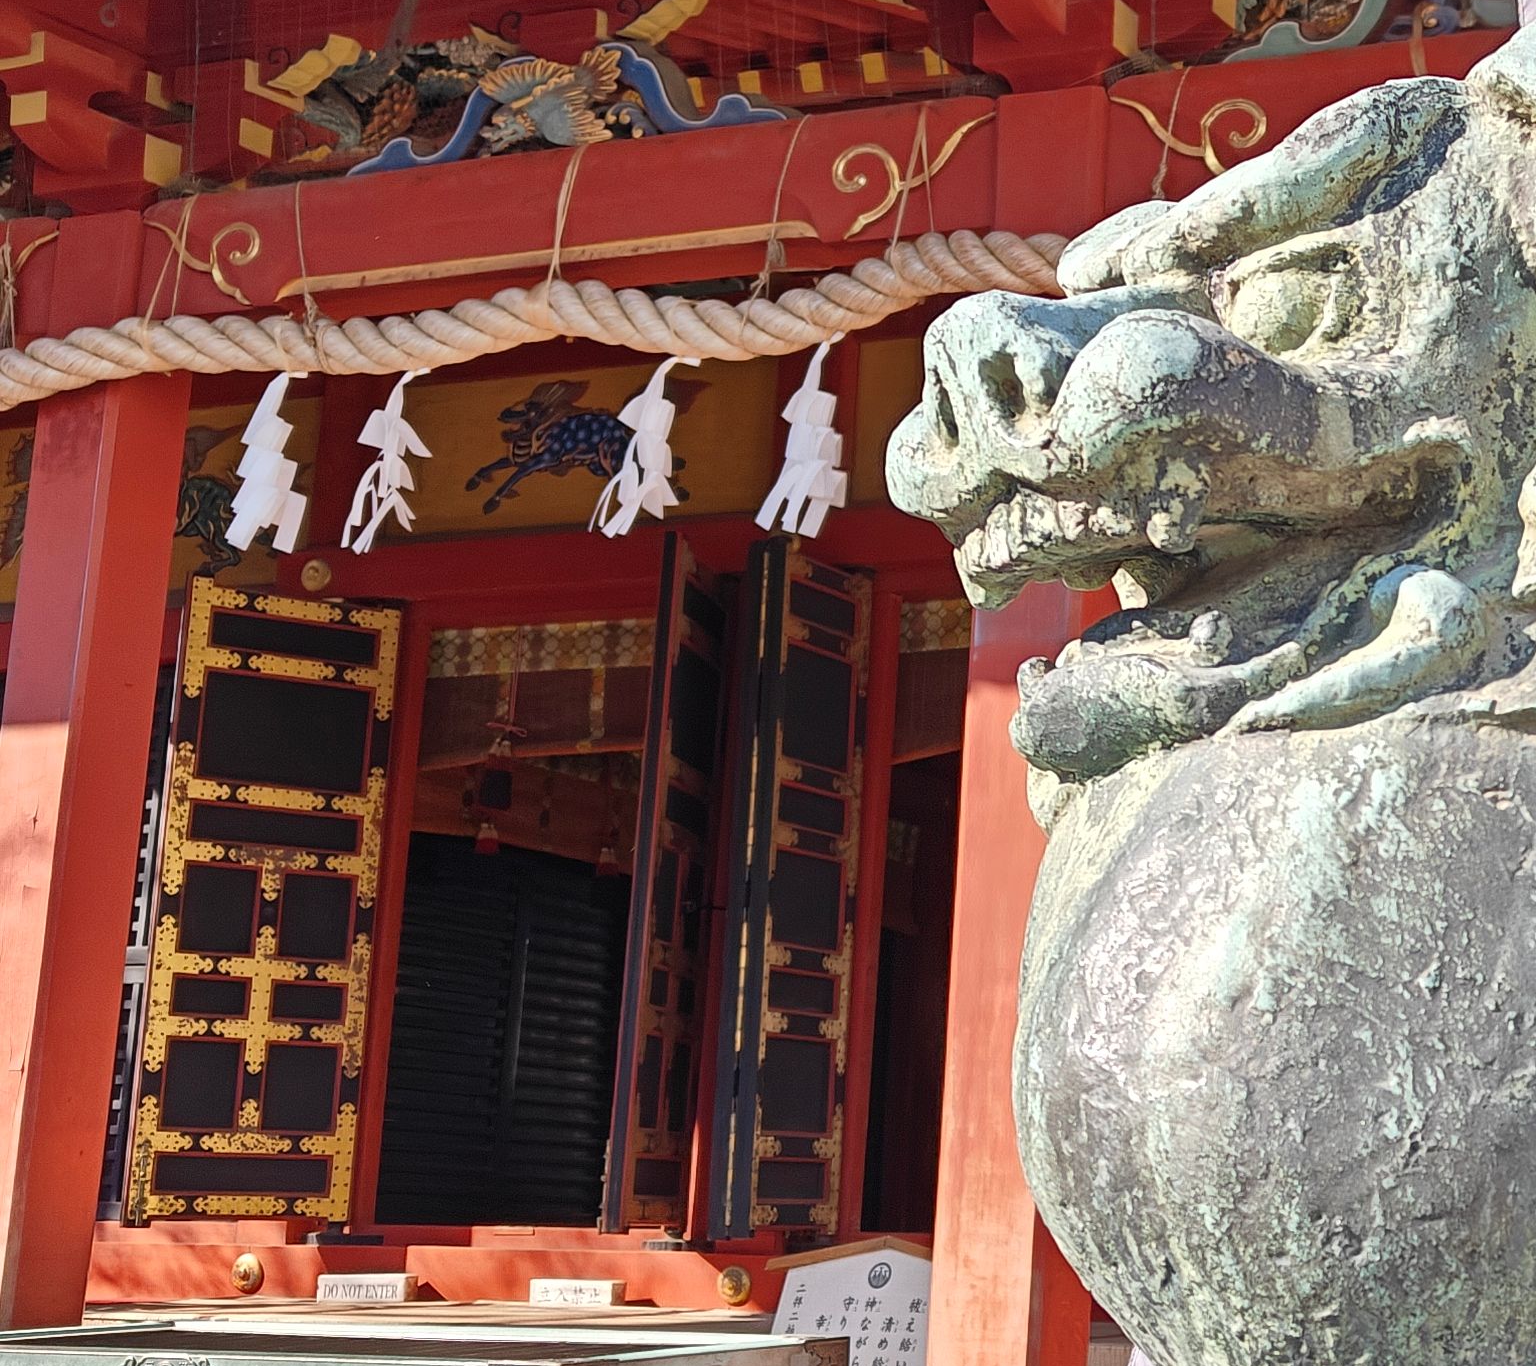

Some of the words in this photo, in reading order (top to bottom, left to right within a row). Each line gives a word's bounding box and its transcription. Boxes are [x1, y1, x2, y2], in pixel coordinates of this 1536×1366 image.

[323, 1283, 339, 1300] DO
[342, 1283, 365, 1300] NOT
[365, 1283, 398, 1300] ENTER
[537, 1285, 602, 1305] 立入禁止
